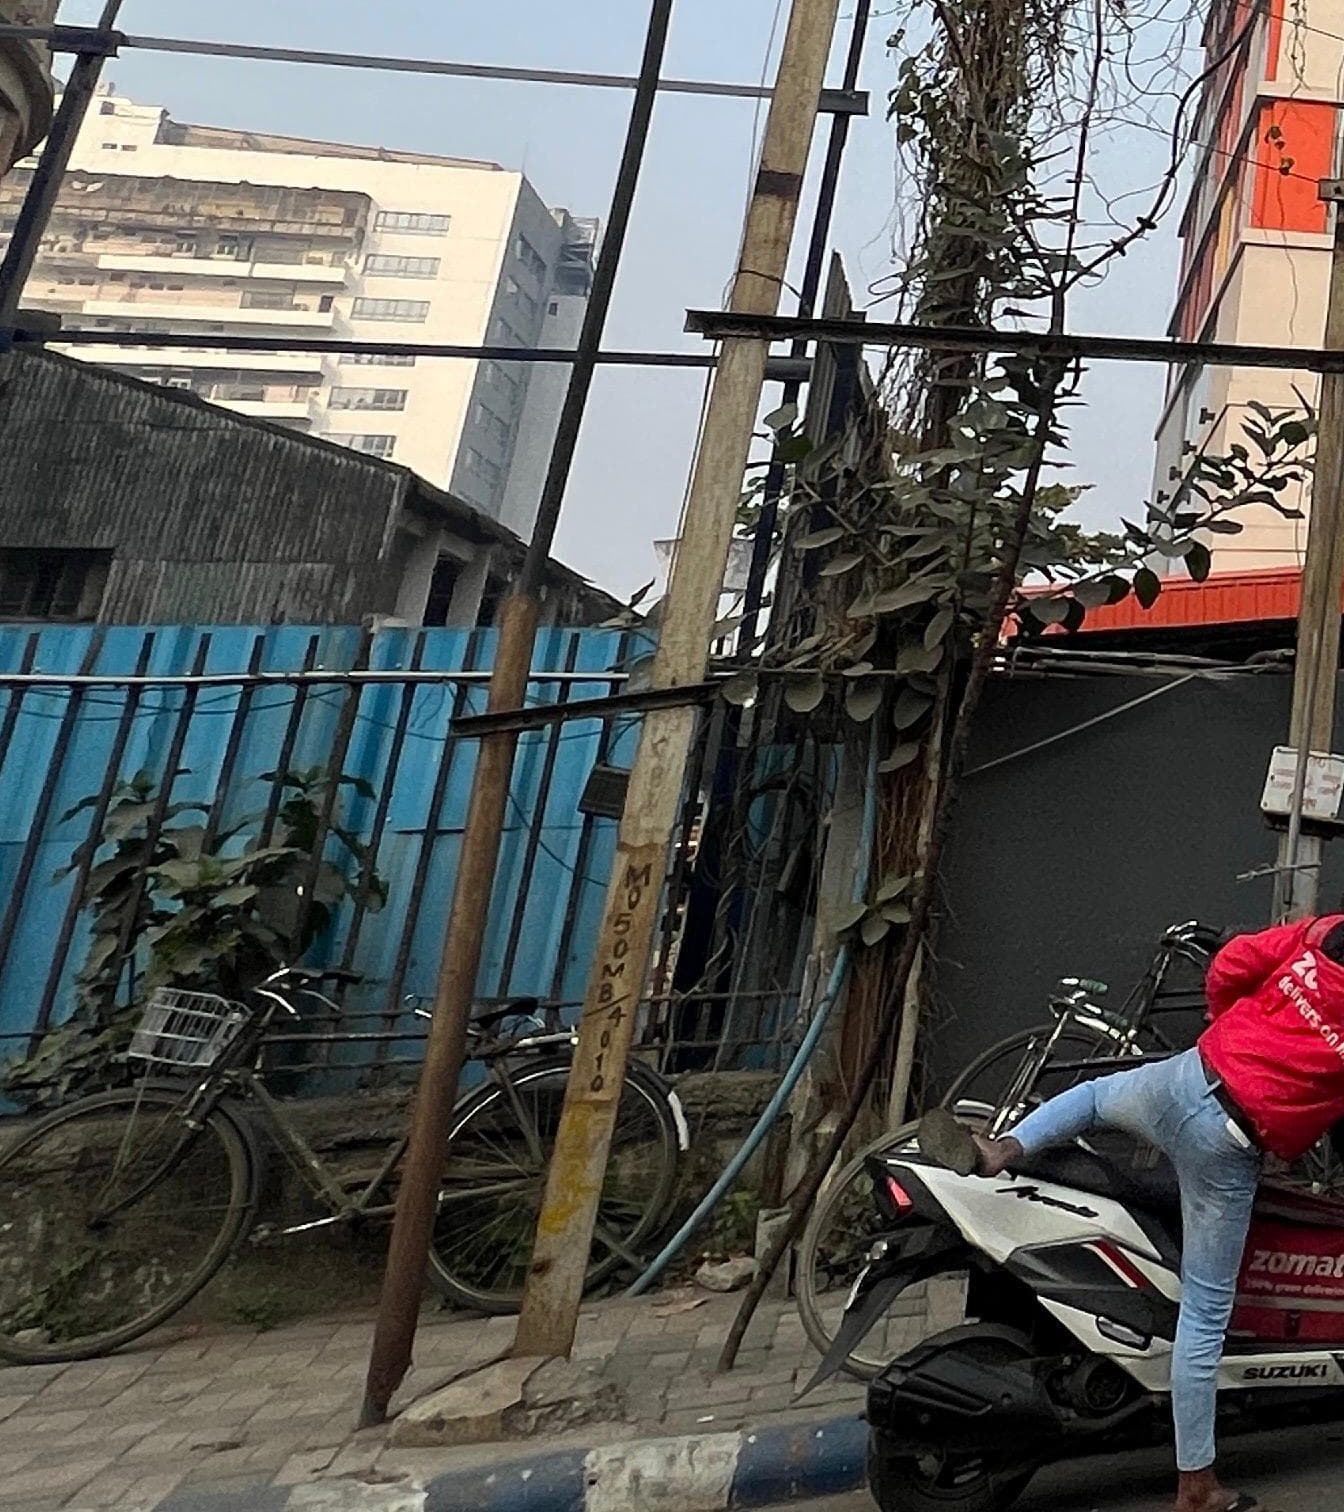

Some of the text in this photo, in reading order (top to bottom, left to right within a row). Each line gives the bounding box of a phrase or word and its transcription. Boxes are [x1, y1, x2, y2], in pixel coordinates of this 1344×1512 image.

[1279, 975, 1323, 1029] delivers
[1320, 1024, 1340, 1047] on
[1243, 1364, 1328, 1380] SUZUKI
